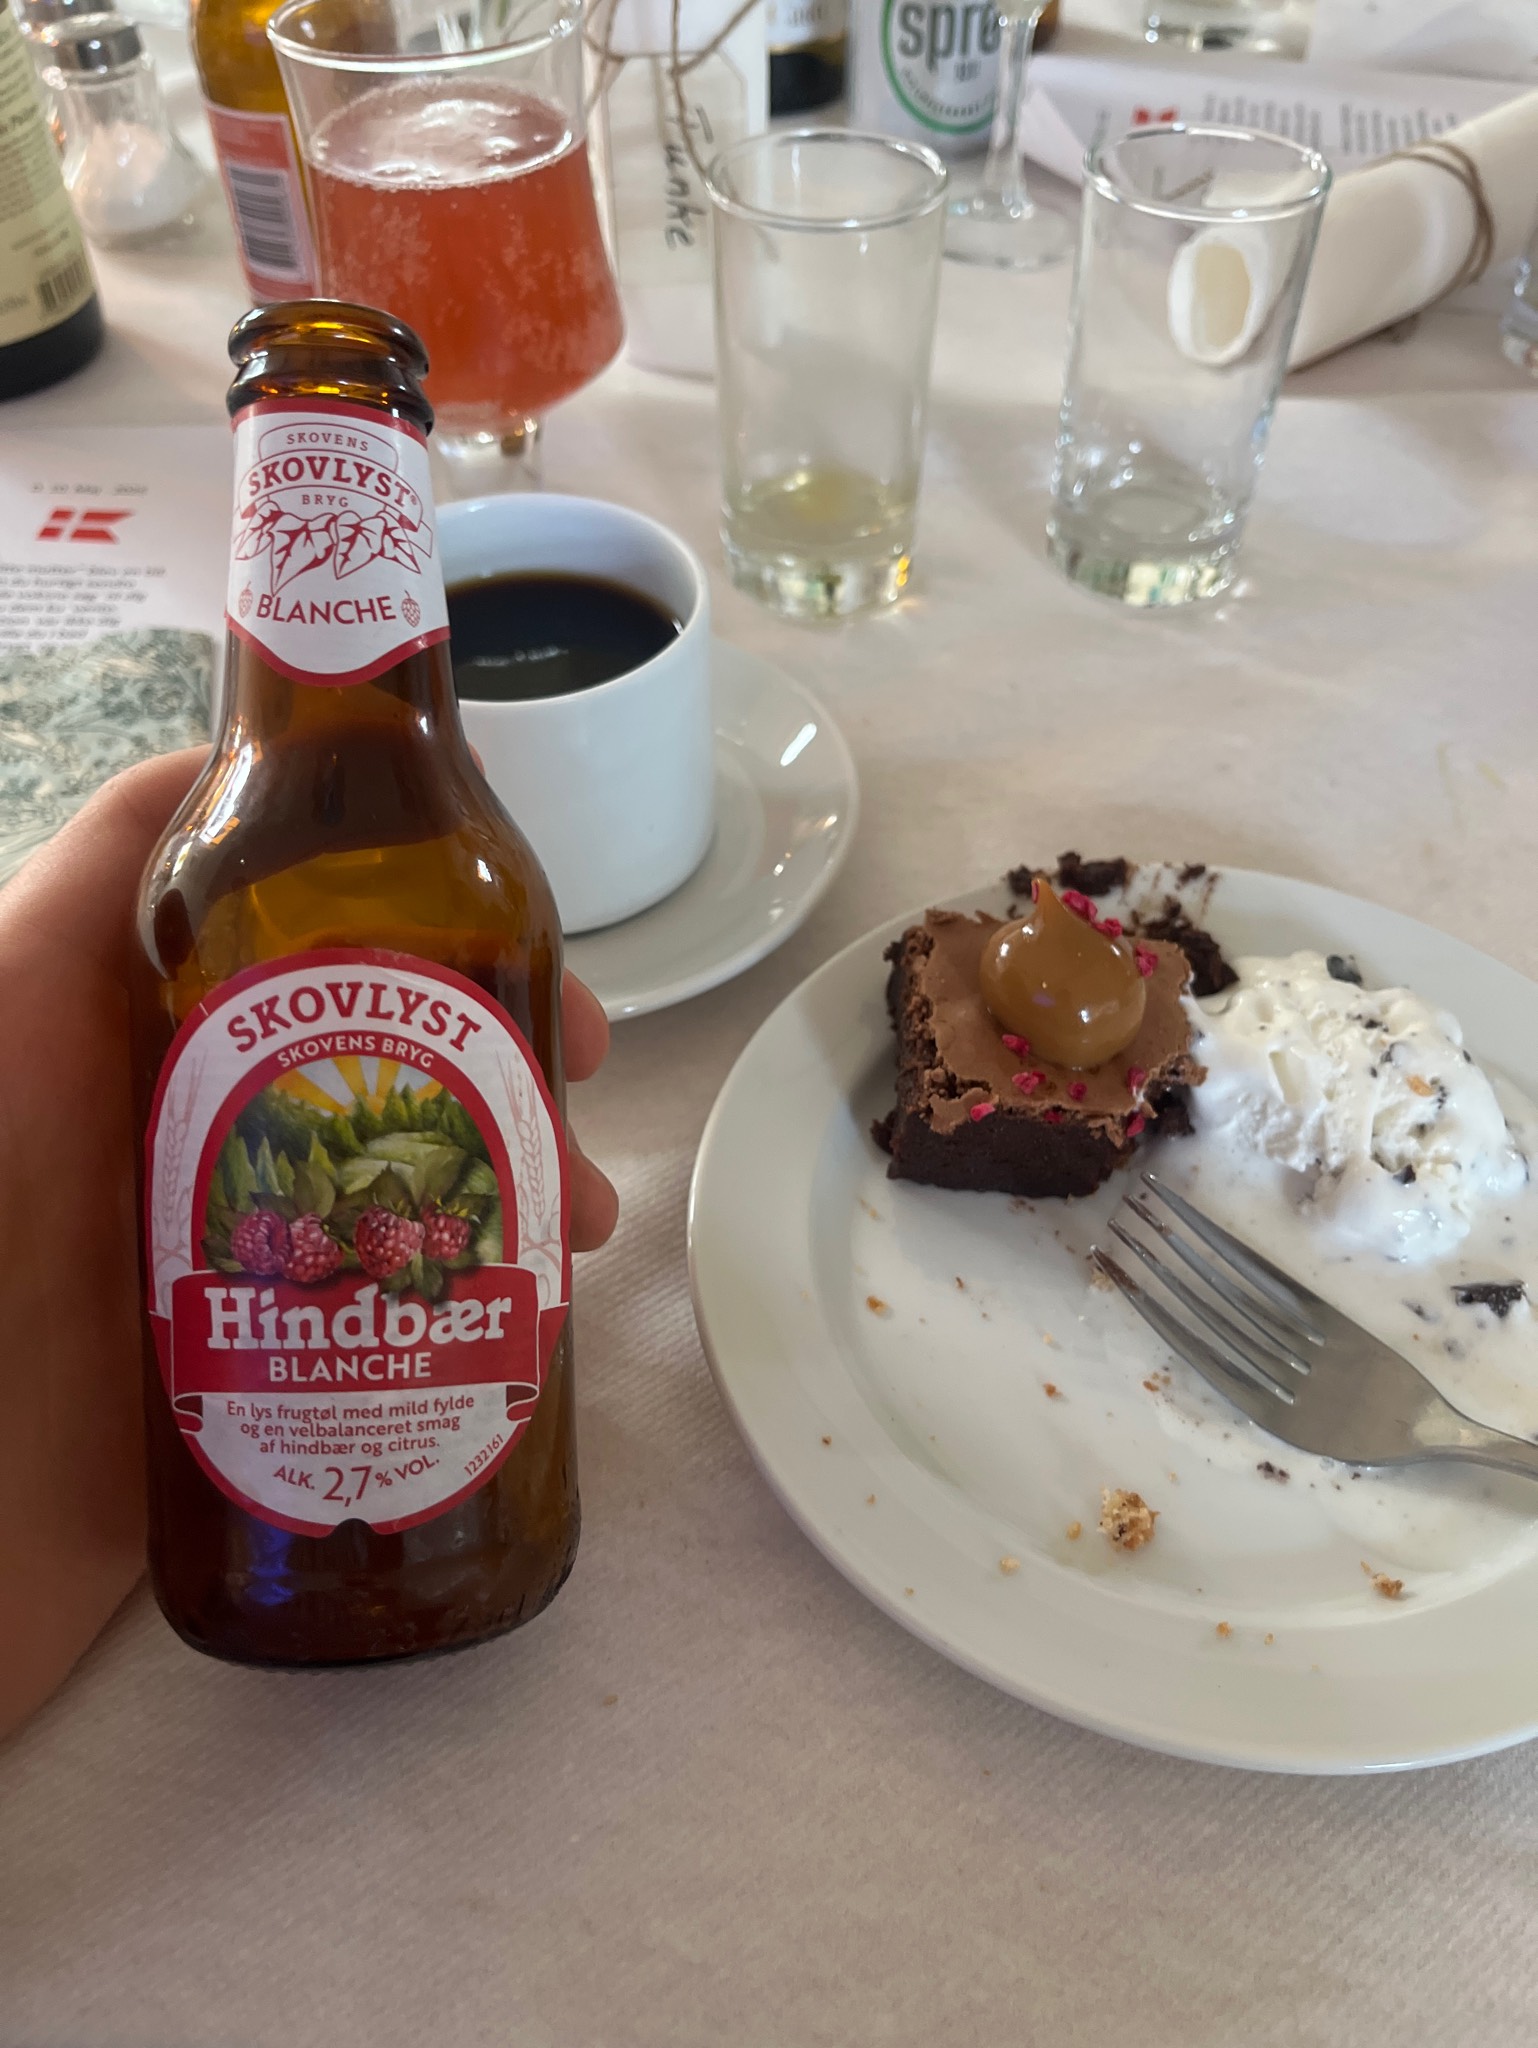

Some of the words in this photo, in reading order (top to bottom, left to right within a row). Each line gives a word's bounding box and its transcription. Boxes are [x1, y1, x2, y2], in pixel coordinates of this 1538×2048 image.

[286, 432, 369, 452] SKOVENS
[301, 494, 349, 508] BRYG
[256, 593, 397, 625] BLANCHE
[227, 981, 482, 1053] SKOVLYST
[278, 1035, 375, 1068] SKOVENS
[381, 1038, 435, 1068] BRYG
[204, 1283, 512, 1350] Hindbær
[269, 1351, 432, 1382] BLANCHE
[227, 1400, 246, 1416] En
[251, 1403, 272, 1421] lys
[277, 1404, 337, 1424] frugtøl
[343, 1404, 383, 1419] med
[389, 1400, 428, 1417] mild
[433, 1395, 474, 1416] fylde
[240, 1423, 259, 1438] og
[264, 1424, 284, 1437] en
[289, 1420, 412, 1438] velbalanceret
[417, 1416, 460, 1431] smag
[259, 1440, 275, 1454] af
[281, 1440, 356, 1455] hindbær
[361, 1443, 383, 1457] og
[388, 1436, 440, 1452] citrus.
[464, 1433, 504, 1476] 1232161
[273, 1465, 315, 1490] ALK.
[394, 1455, 440, 1480] VOL.
